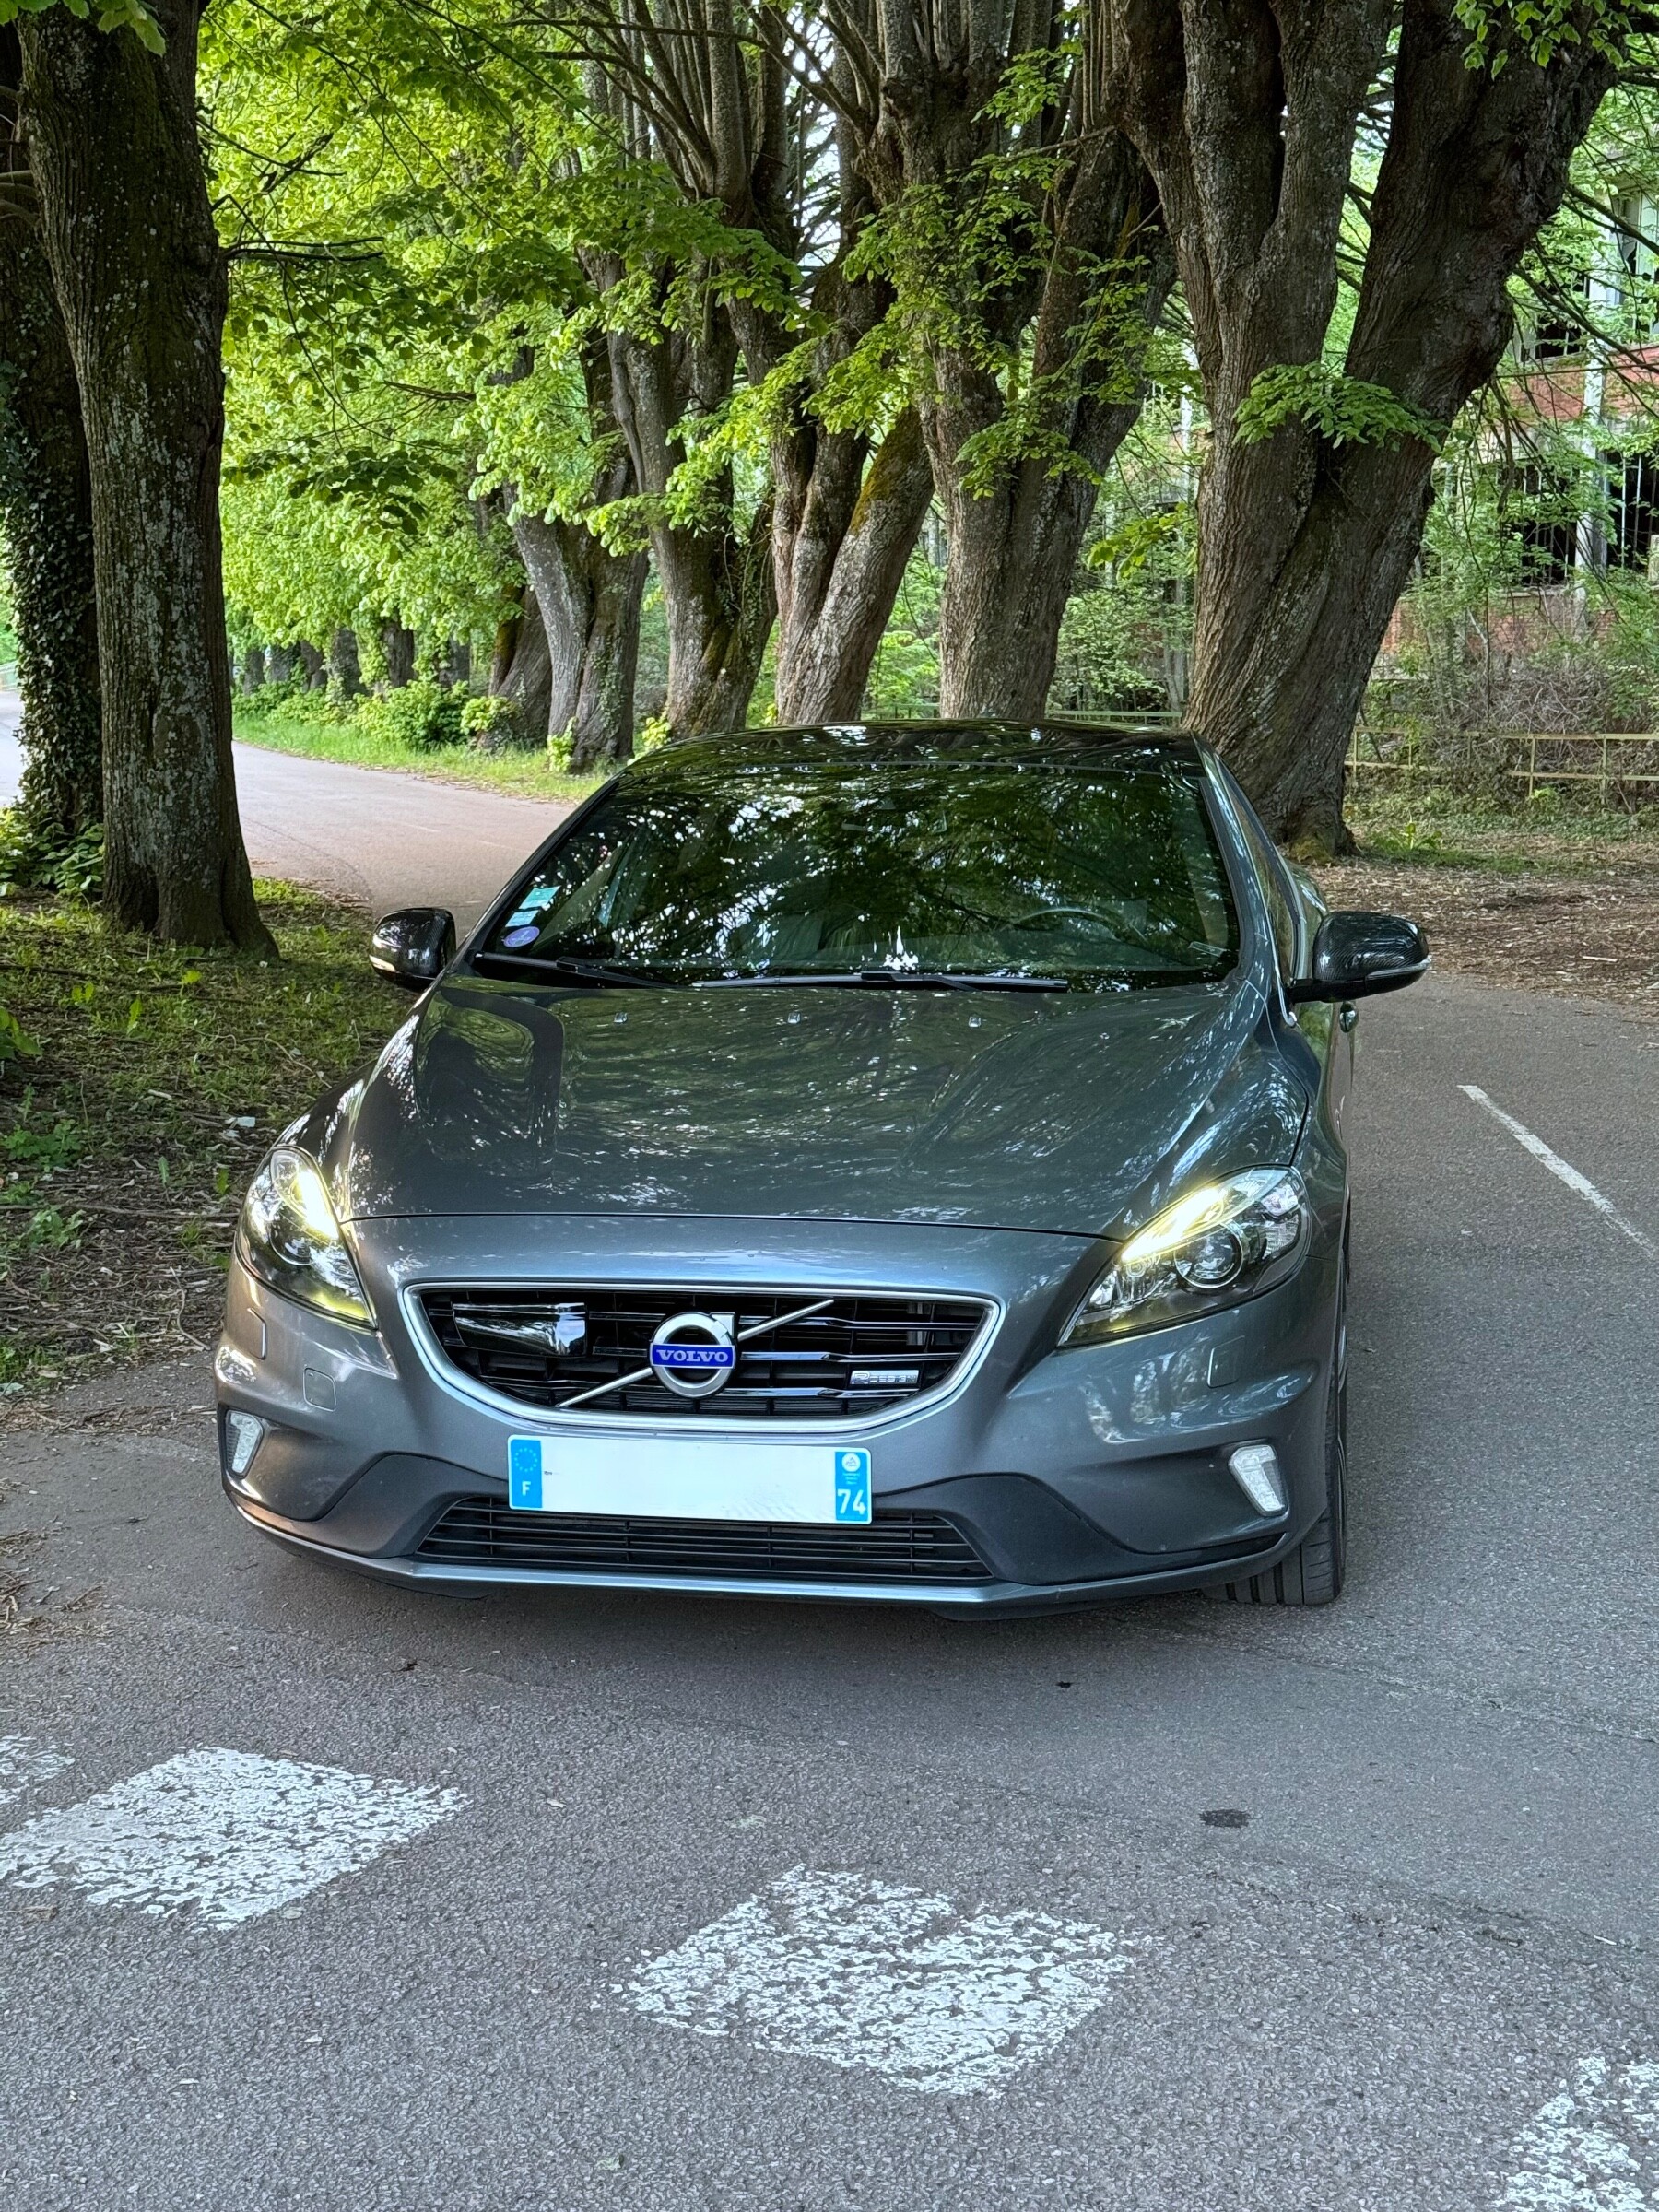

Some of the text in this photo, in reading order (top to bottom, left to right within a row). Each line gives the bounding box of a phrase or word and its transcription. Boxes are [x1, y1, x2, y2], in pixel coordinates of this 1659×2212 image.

[655, 1349, 729, 1363] VOLVO
[522, 1480, 532, 1497] F
[837, 1488, 866, 1515] 74
